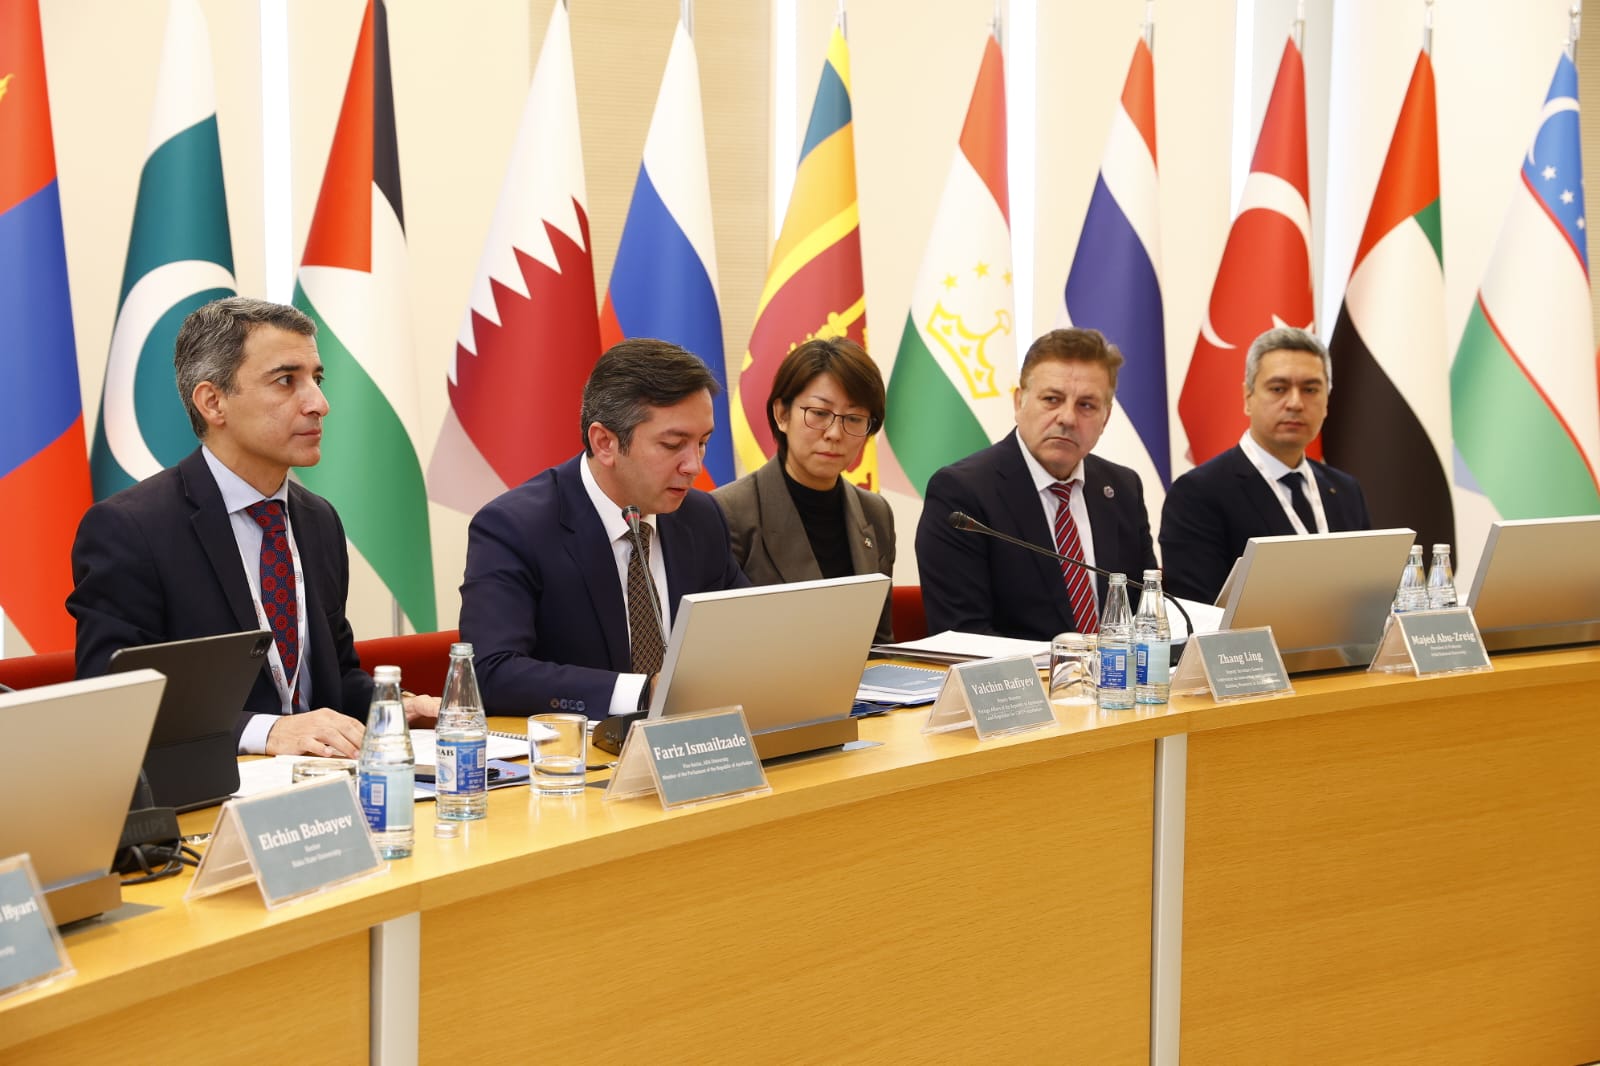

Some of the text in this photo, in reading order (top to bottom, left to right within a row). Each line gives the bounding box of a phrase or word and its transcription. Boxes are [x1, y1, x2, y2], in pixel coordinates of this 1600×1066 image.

[1411, 632, 1476, 646] Majed Abu-Zreig
[1218, 651, 1263, 664] Zhang Ling
[971, 677, 1034, 695] Yalchin Rafiyev
[653, 733, 747, 760] Fariz Ismailzade
[258, 815, 352, 851] Elchin Babayev
